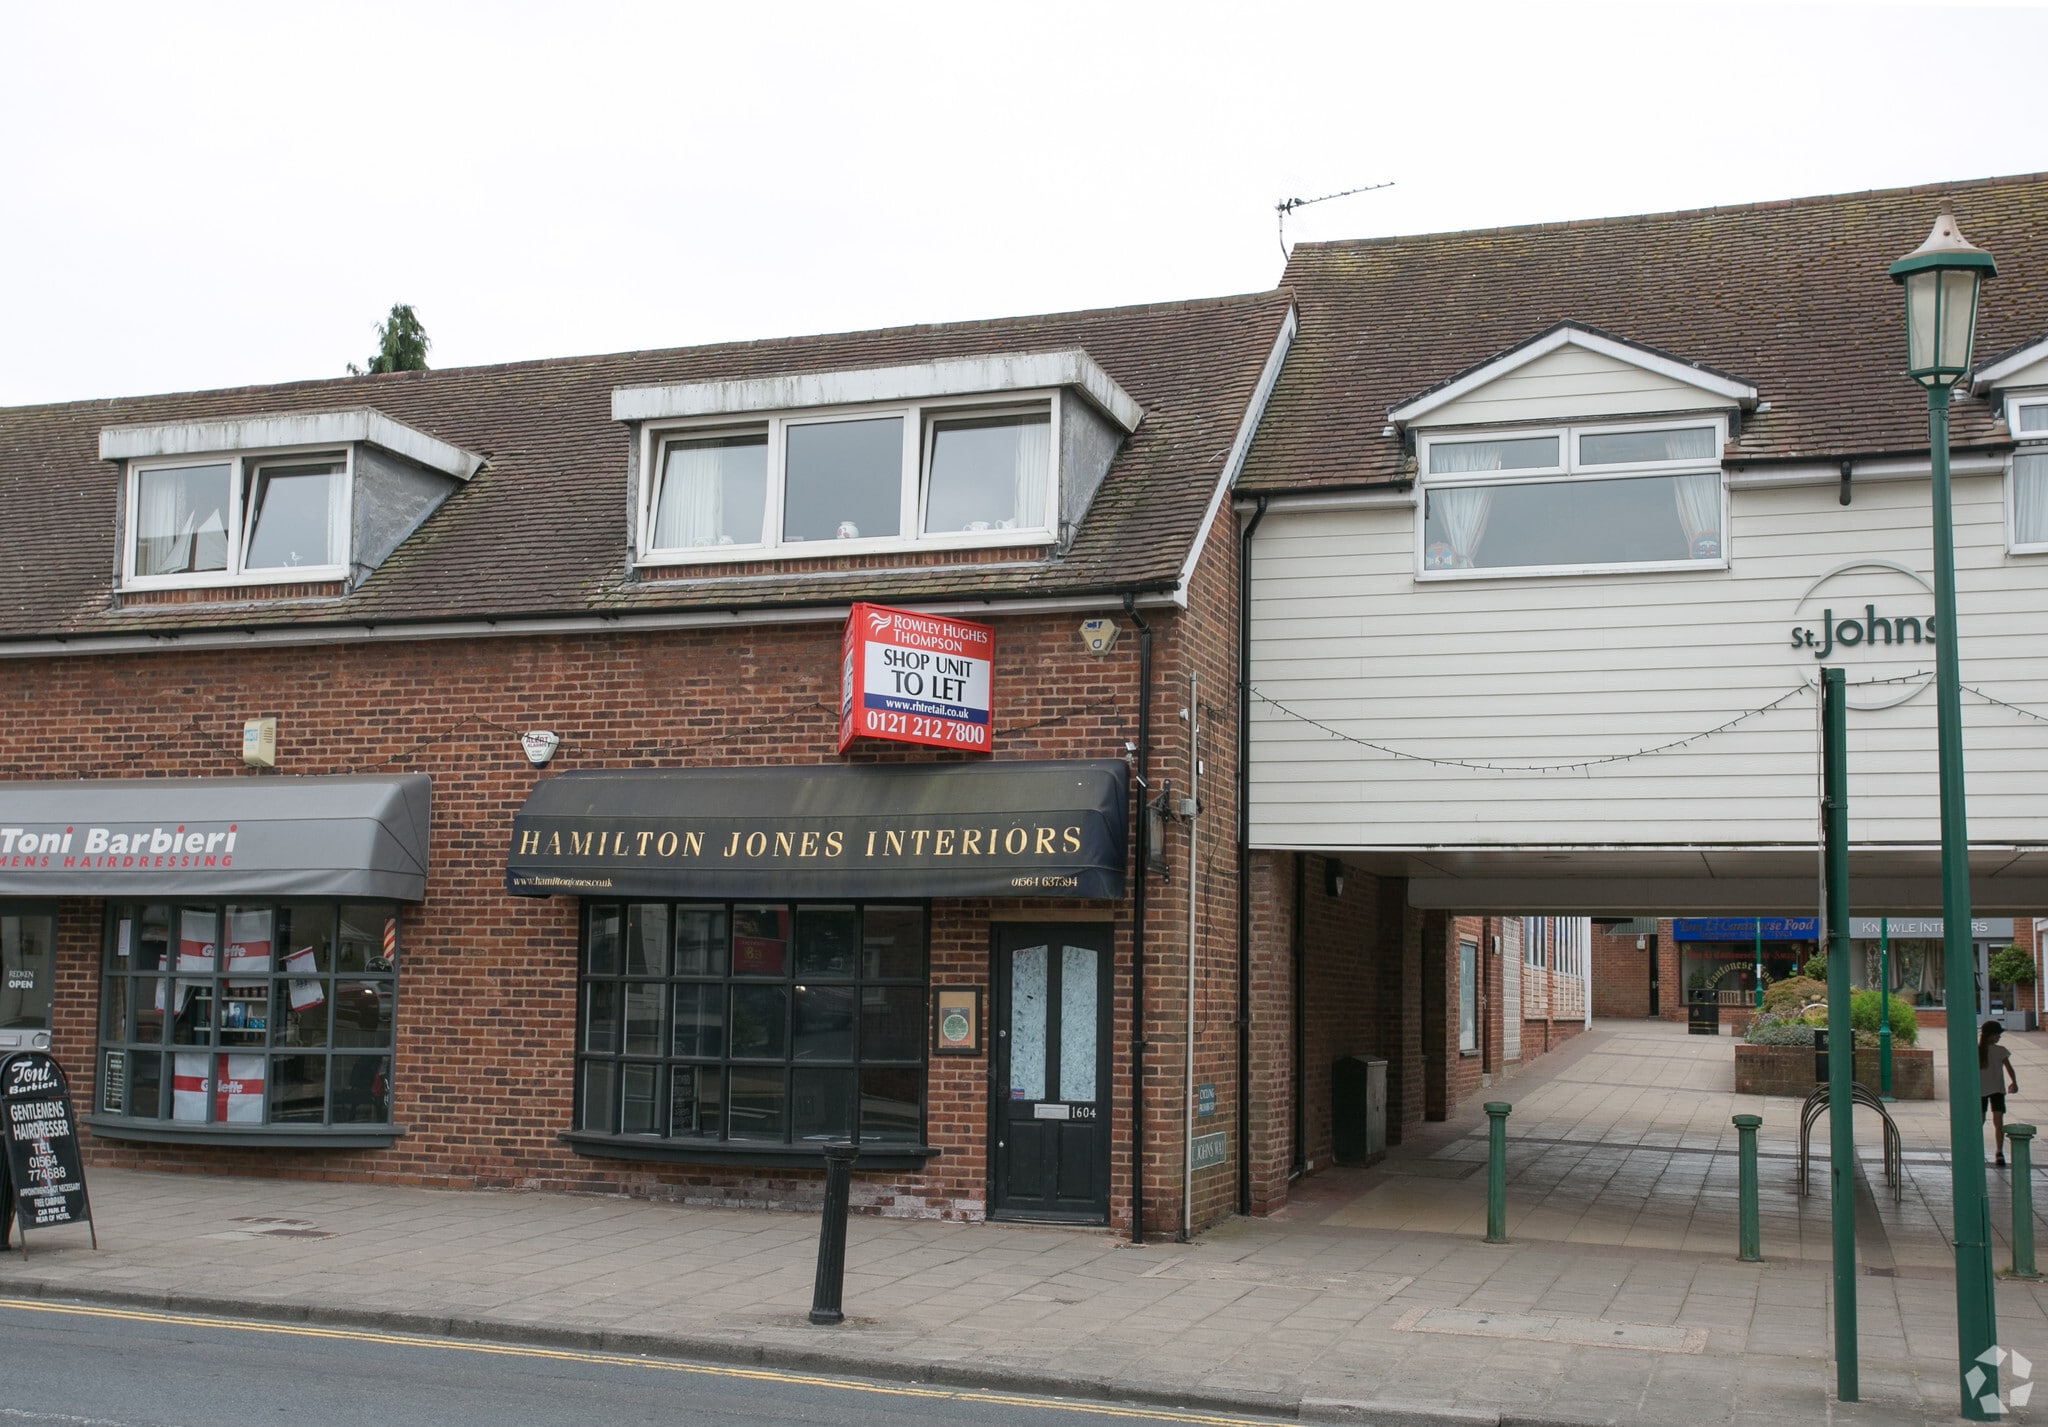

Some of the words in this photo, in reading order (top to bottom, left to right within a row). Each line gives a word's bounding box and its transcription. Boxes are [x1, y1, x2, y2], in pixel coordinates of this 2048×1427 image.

[893, 614, 941, 635] ROWLEY
[943, 624, 988, 643] HUGHES
[893, 628, 963, 652] THOMPSON
[884, 648, 930, 670] SHOP
[936, 656, 973, 677] UNIT
[891, 670, 924, 695] TO
[932, 676, 967, 702] LET
[886, 699, 969, 719] www.rhtretail.co.uk
[867, 710, 907, 734] 0121
[912, 717, 942, 739] 212
[946, 722, 985, 745] 7800
[0, 826, 74, 853] Toni
[84, 824, 238, 854] Barbieri
[518, 830, 705, 857] HAMILTON
[723, 830, 844, 858] JONES
[865, 826, 1081, 857] INTERIORS
[63, 855, 233, 867] HAIRDRESSING
[513, 876, 613, 888] www.hamiltonjones.co.uk
[1011, 876, 1039, 887] 01564
[1041, 876, 1078, 887] 637394
[1783, 918, 1815, 931] Food
[8, 980, 34, 989] OPEN
[1705, 961, 1754, 989] Cantonese
[11, 1061, 50, 1083] Toni
[9, 1079, 58, 1094] Barbieri
[201, 1079, 243, 1094] Glette
[10, 1101, 65, 1121] GENTLEMENS
[1071, 1106, 1096, 1119] 1604
[13, 1120, 70, 1140] HAIRDRESSER
[32, 1142, 54, 1155] TEL
[29, 1155, 58, 1168] 01564
[28, 1166, 66, 1181] 774688
